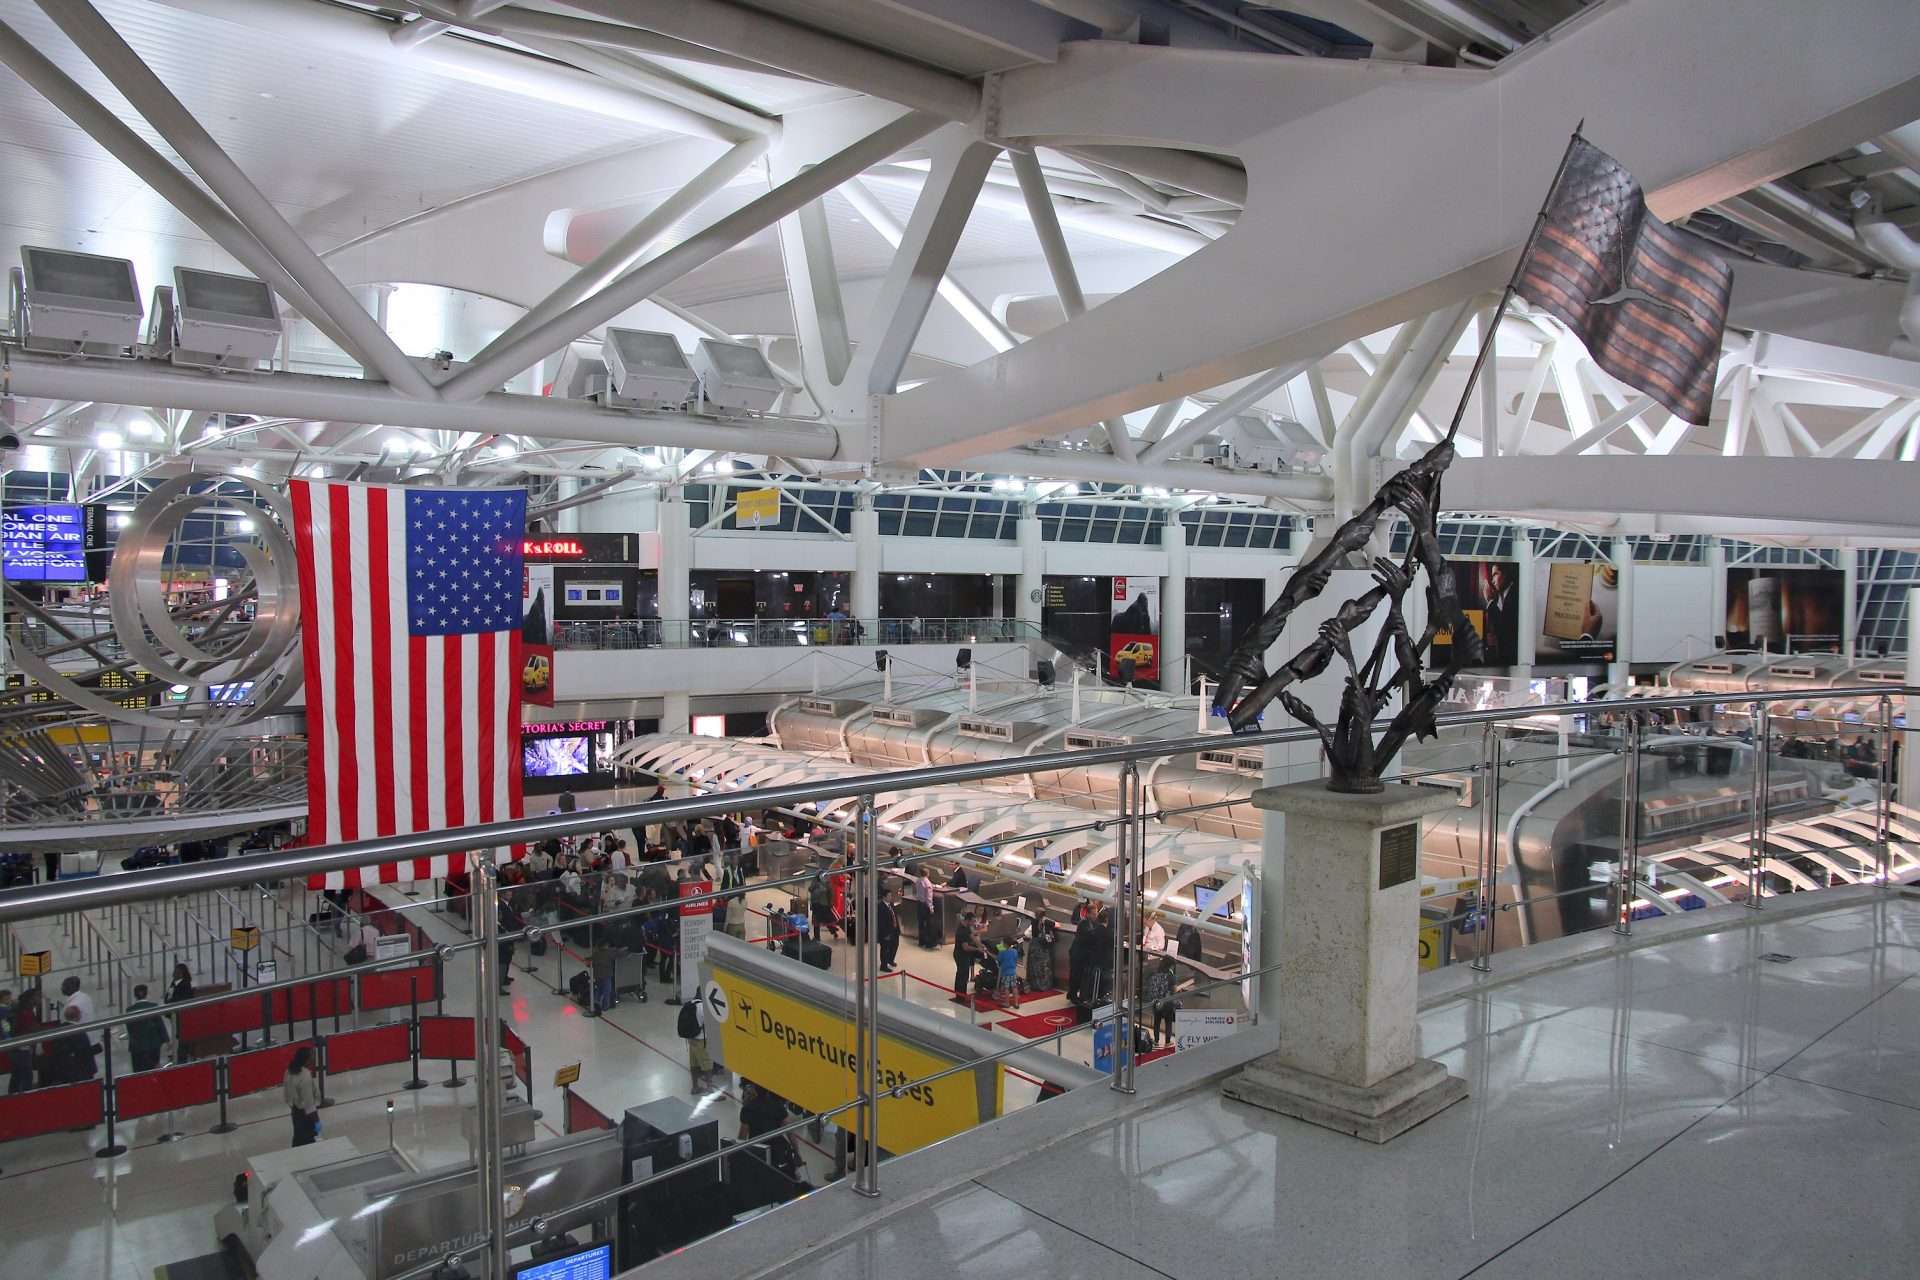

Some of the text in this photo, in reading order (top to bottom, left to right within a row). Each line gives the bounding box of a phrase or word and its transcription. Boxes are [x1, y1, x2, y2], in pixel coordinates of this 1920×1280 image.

[32, 514, 73, 523] ONE
[49, 532, 81, 541] AIR
[9, 558, 85, 568] AIRPORT
[568, 720, 607, 732] SECRET
[760, 1008, 858, 1075] Departure
[1187, 1035, 1201, 1044] FLY
[394, 1232, 491, 1264] DEPARTUR
